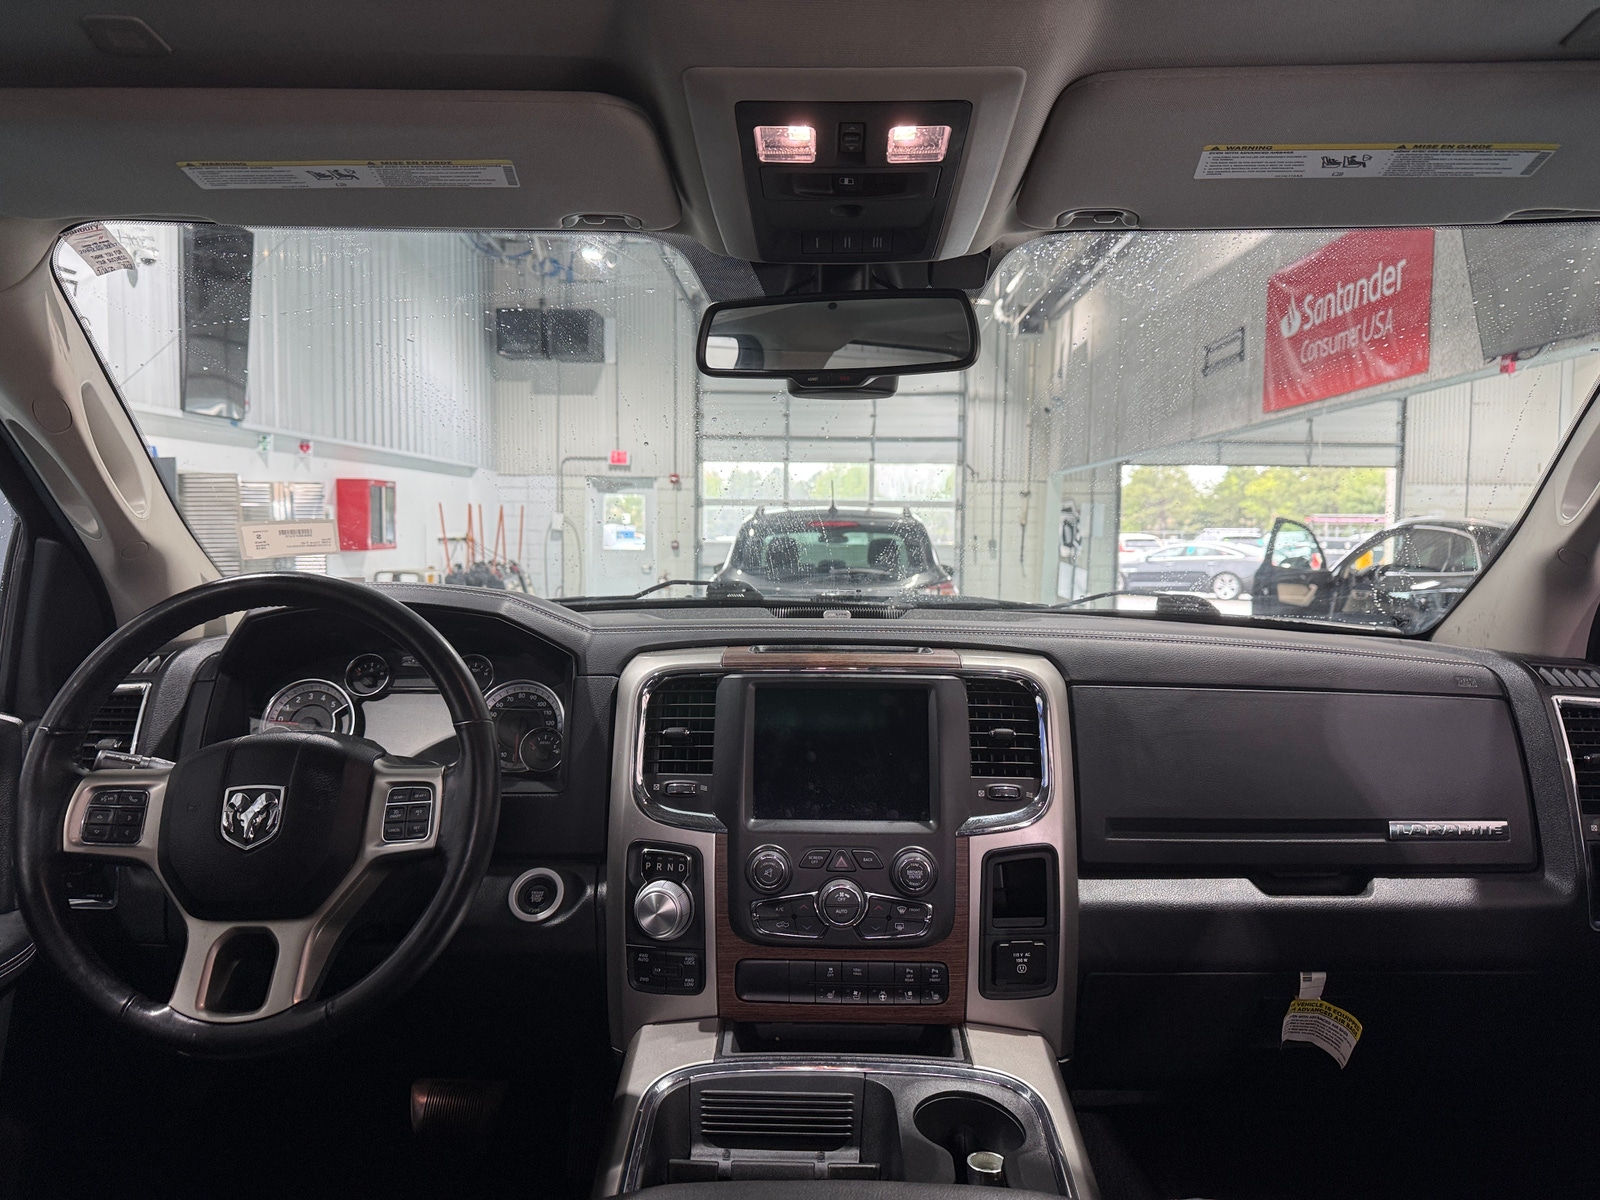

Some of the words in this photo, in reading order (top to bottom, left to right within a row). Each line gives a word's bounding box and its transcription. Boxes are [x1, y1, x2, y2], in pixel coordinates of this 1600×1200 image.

[1302, 259, 1407, 331] Santander
[1301, 324, 1361, 363] Consumer
[1362, 308, 1394, 342] USA
[645, 862, 652, 870] P
[656, 862, 663, 871] R
[667, 863, 674, 872] N
[678, 863, 685, 872] D
[1297, 1007, 1333, 1018] ADVANCED
[1334, 1016, 1347, 1025] AIR
